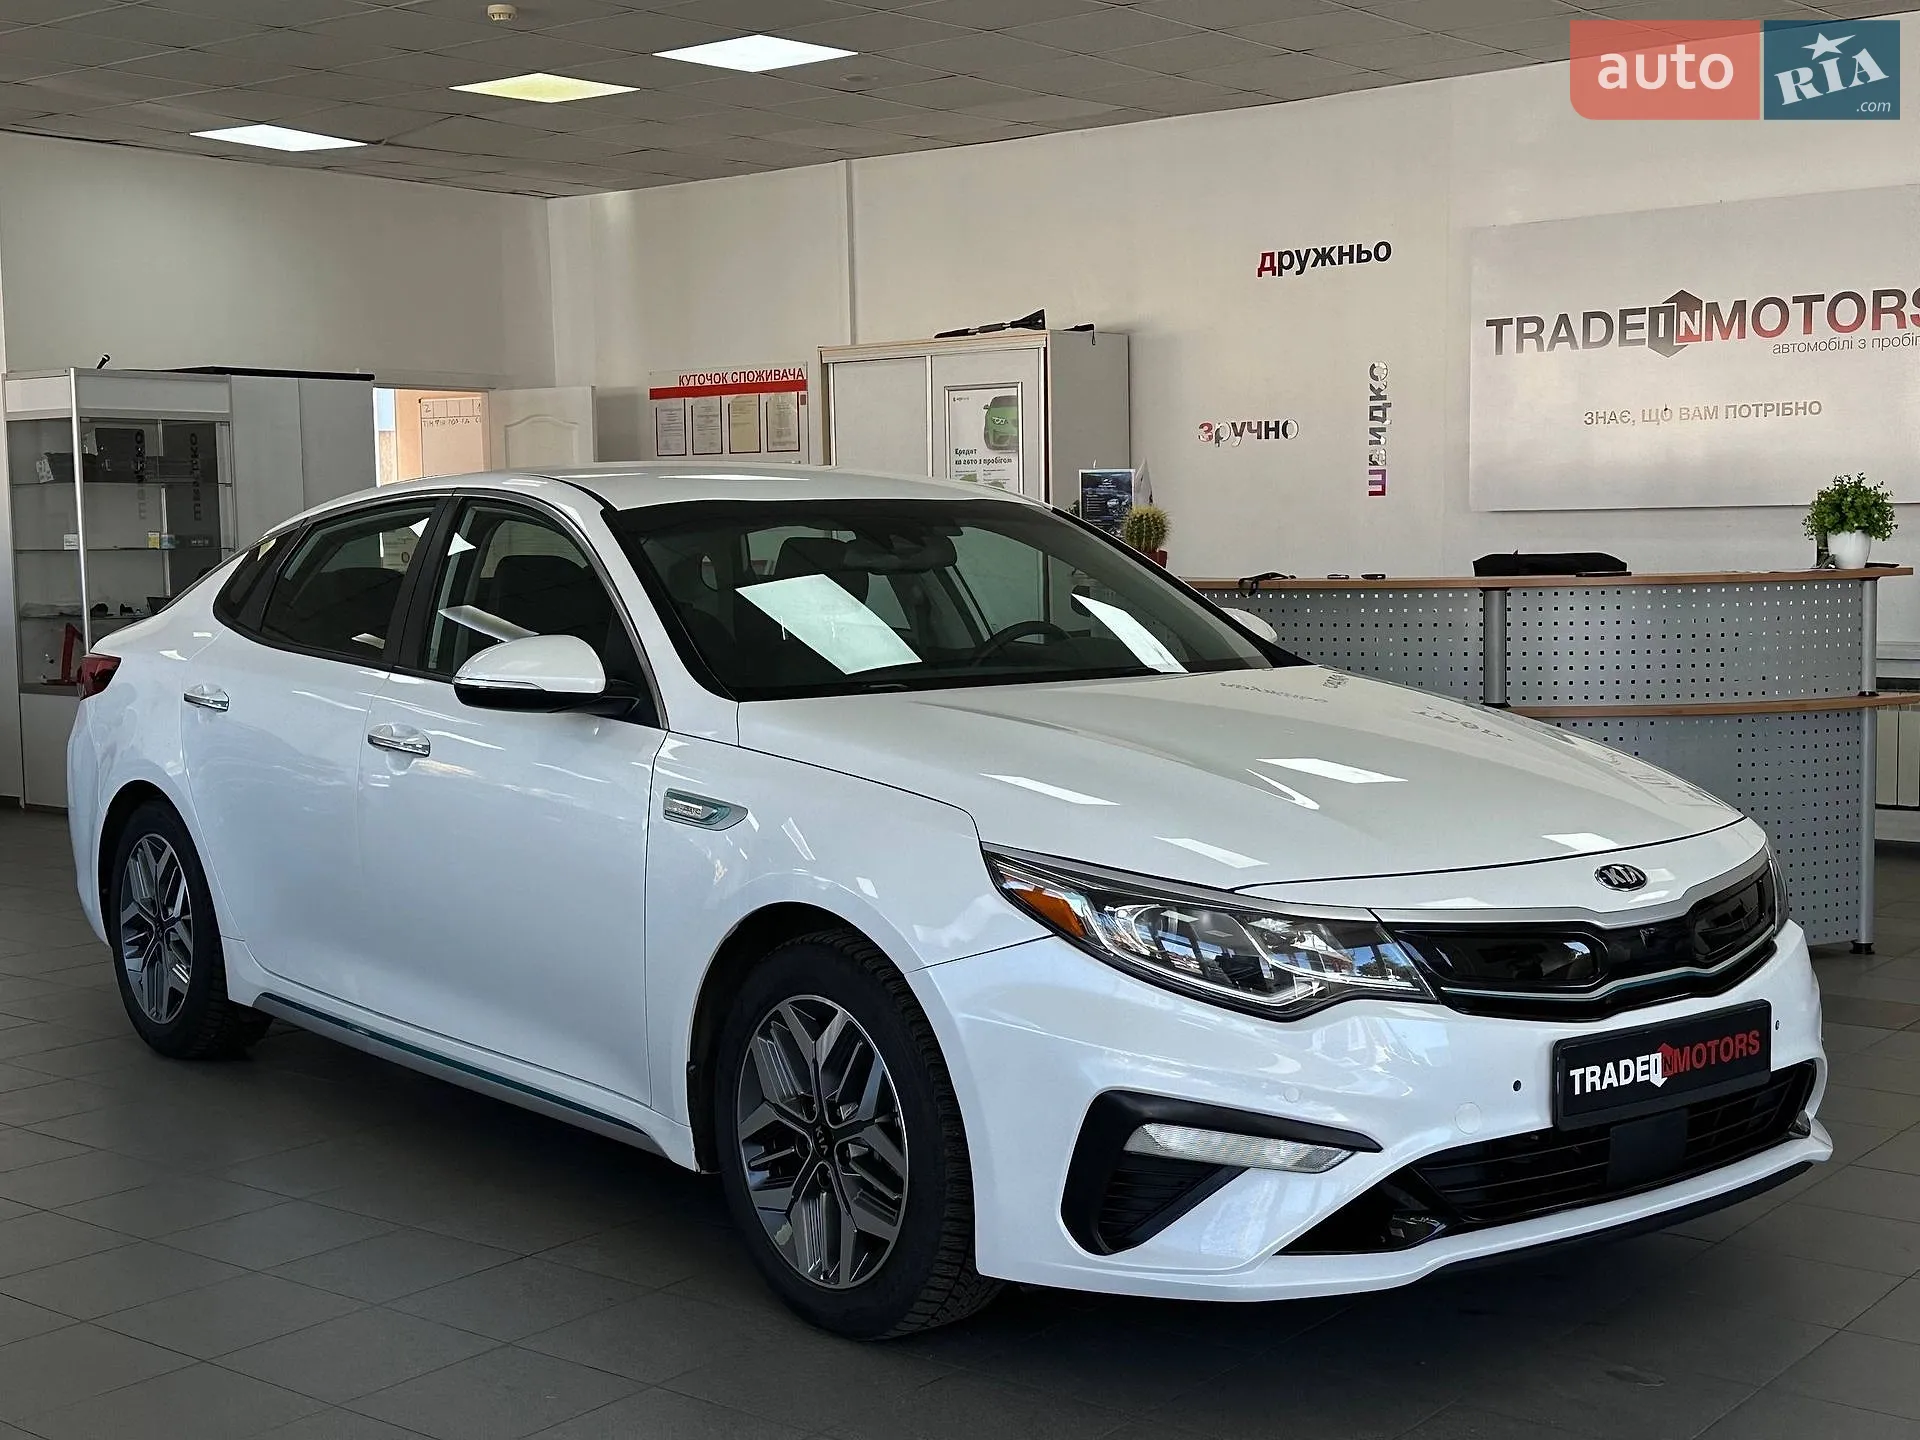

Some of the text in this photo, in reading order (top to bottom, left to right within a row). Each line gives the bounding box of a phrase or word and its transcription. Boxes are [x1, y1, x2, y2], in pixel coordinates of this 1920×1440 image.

[1257, 241, 1392, 278] дружньо
[1704, 288, 1920, 342] MOTOR
[1772, 335, 1853, 355] автомобілі
[1858, 337, 1867, 350] з
[679, 368, 804, 386] КУТОЧОК СПОЖИВАЧА
[1584, 400, 1822, 426] ЗНАЄ, ЩО ВАМ ПОТРІБНО
[1198, 418, 1299, 447] зручно
[1368, 361, 1392, 496] швидко
